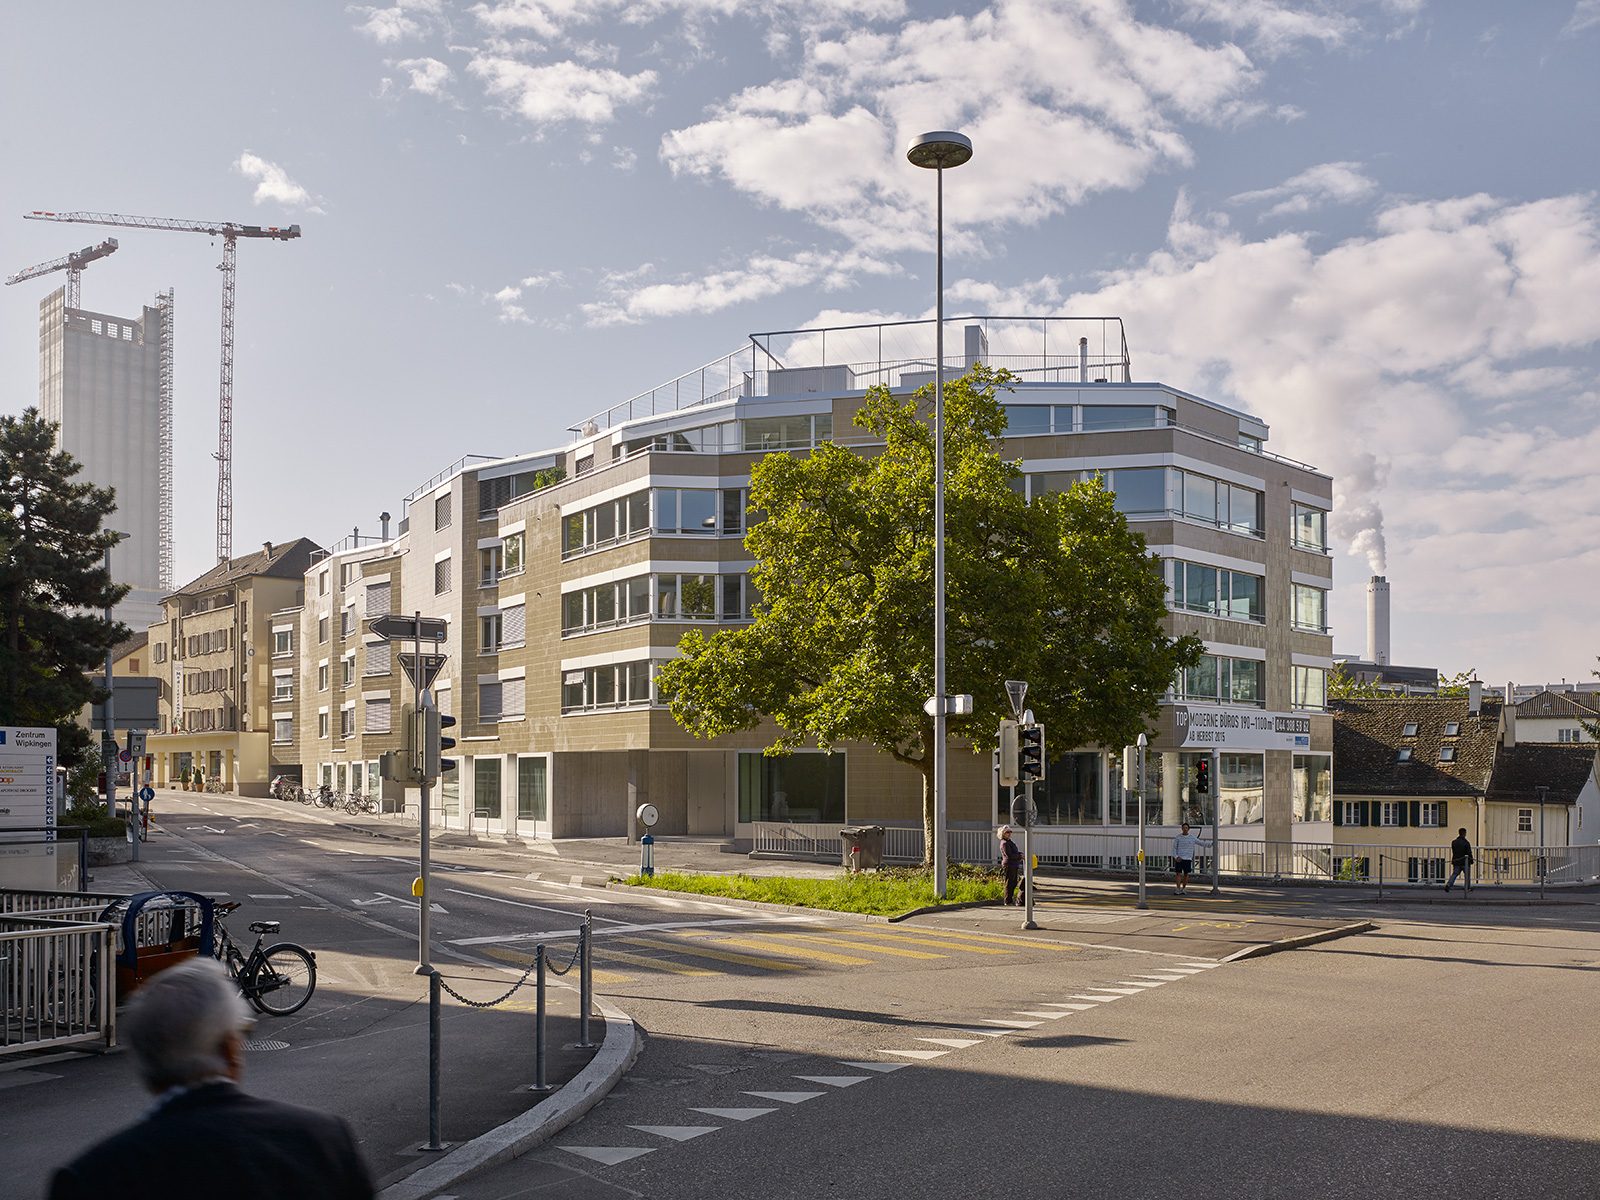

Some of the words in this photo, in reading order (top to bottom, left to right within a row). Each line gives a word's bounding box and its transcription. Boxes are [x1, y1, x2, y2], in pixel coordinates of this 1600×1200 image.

[1176, 711, 1188, 727] TOP
[1189, 712, 1219, 728] MODERNE
[1220, 711, 1240, 729] BÜROS
[16, 731, 46, 739] Zentrum
[1189, 731, 1196, 741] AB
[1196, 731, 1214, 742] HERBST
[1215, 731, 1226, 742] 2015
[16, 740, 52, 748] Wipkingen
